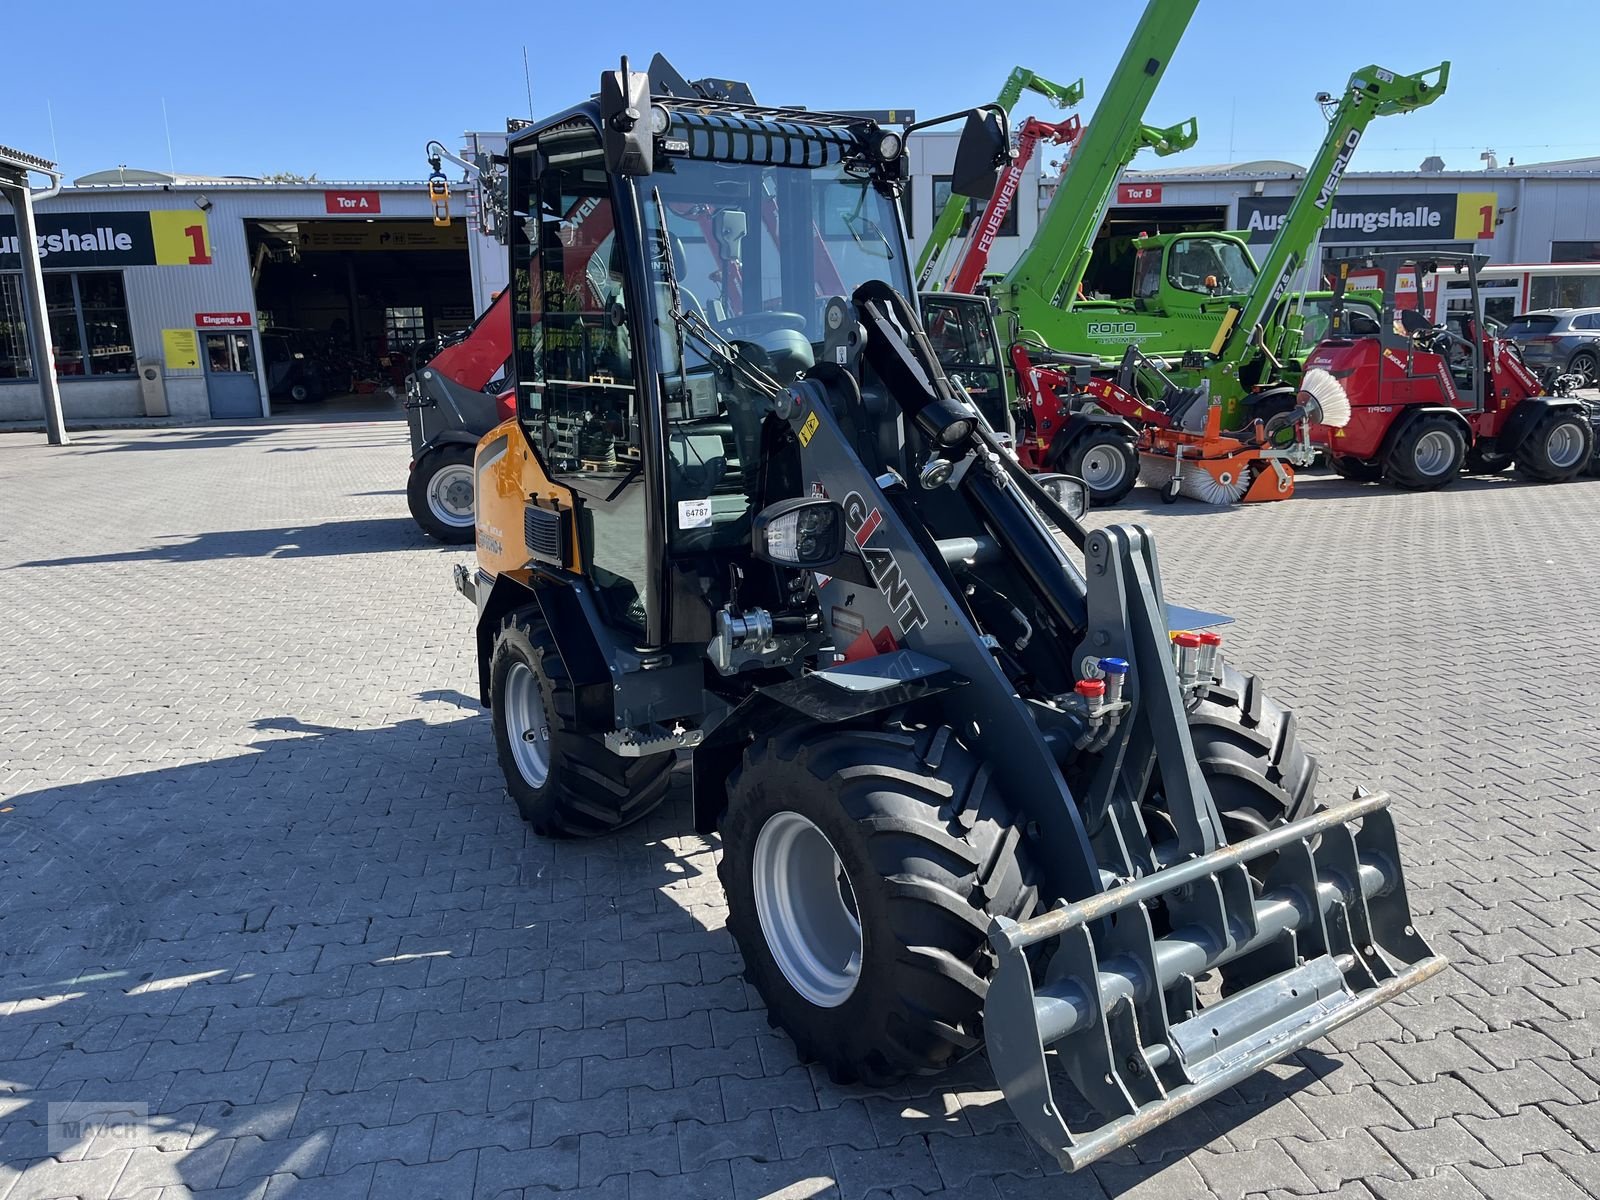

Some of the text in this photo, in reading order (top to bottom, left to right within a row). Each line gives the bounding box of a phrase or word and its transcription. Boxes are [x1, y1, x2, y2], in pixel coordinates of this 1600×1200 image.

[1314, 129, 1360, 209] MERLO
[336, 197, 368, 208] Tor A
[1127, 188, 1152, 198] Tor B
[978, 166, 1022, 253] FEUERWEHR
[1477, 205, 1495, 239] 1
[184, 225, 212, 265] 1
[1273, 274, 1290, 301] 27.6
[1400, 279, 1432, 288] MAH
[202, 315, 243, 325] Eingang A
[1087, 321, 1136, 334] ROTO
[1437, 361, 1457, 400] WEIDEMANN
[685, 508, 708, 518] 64787
[842, 490, 929, 635] GIANT
